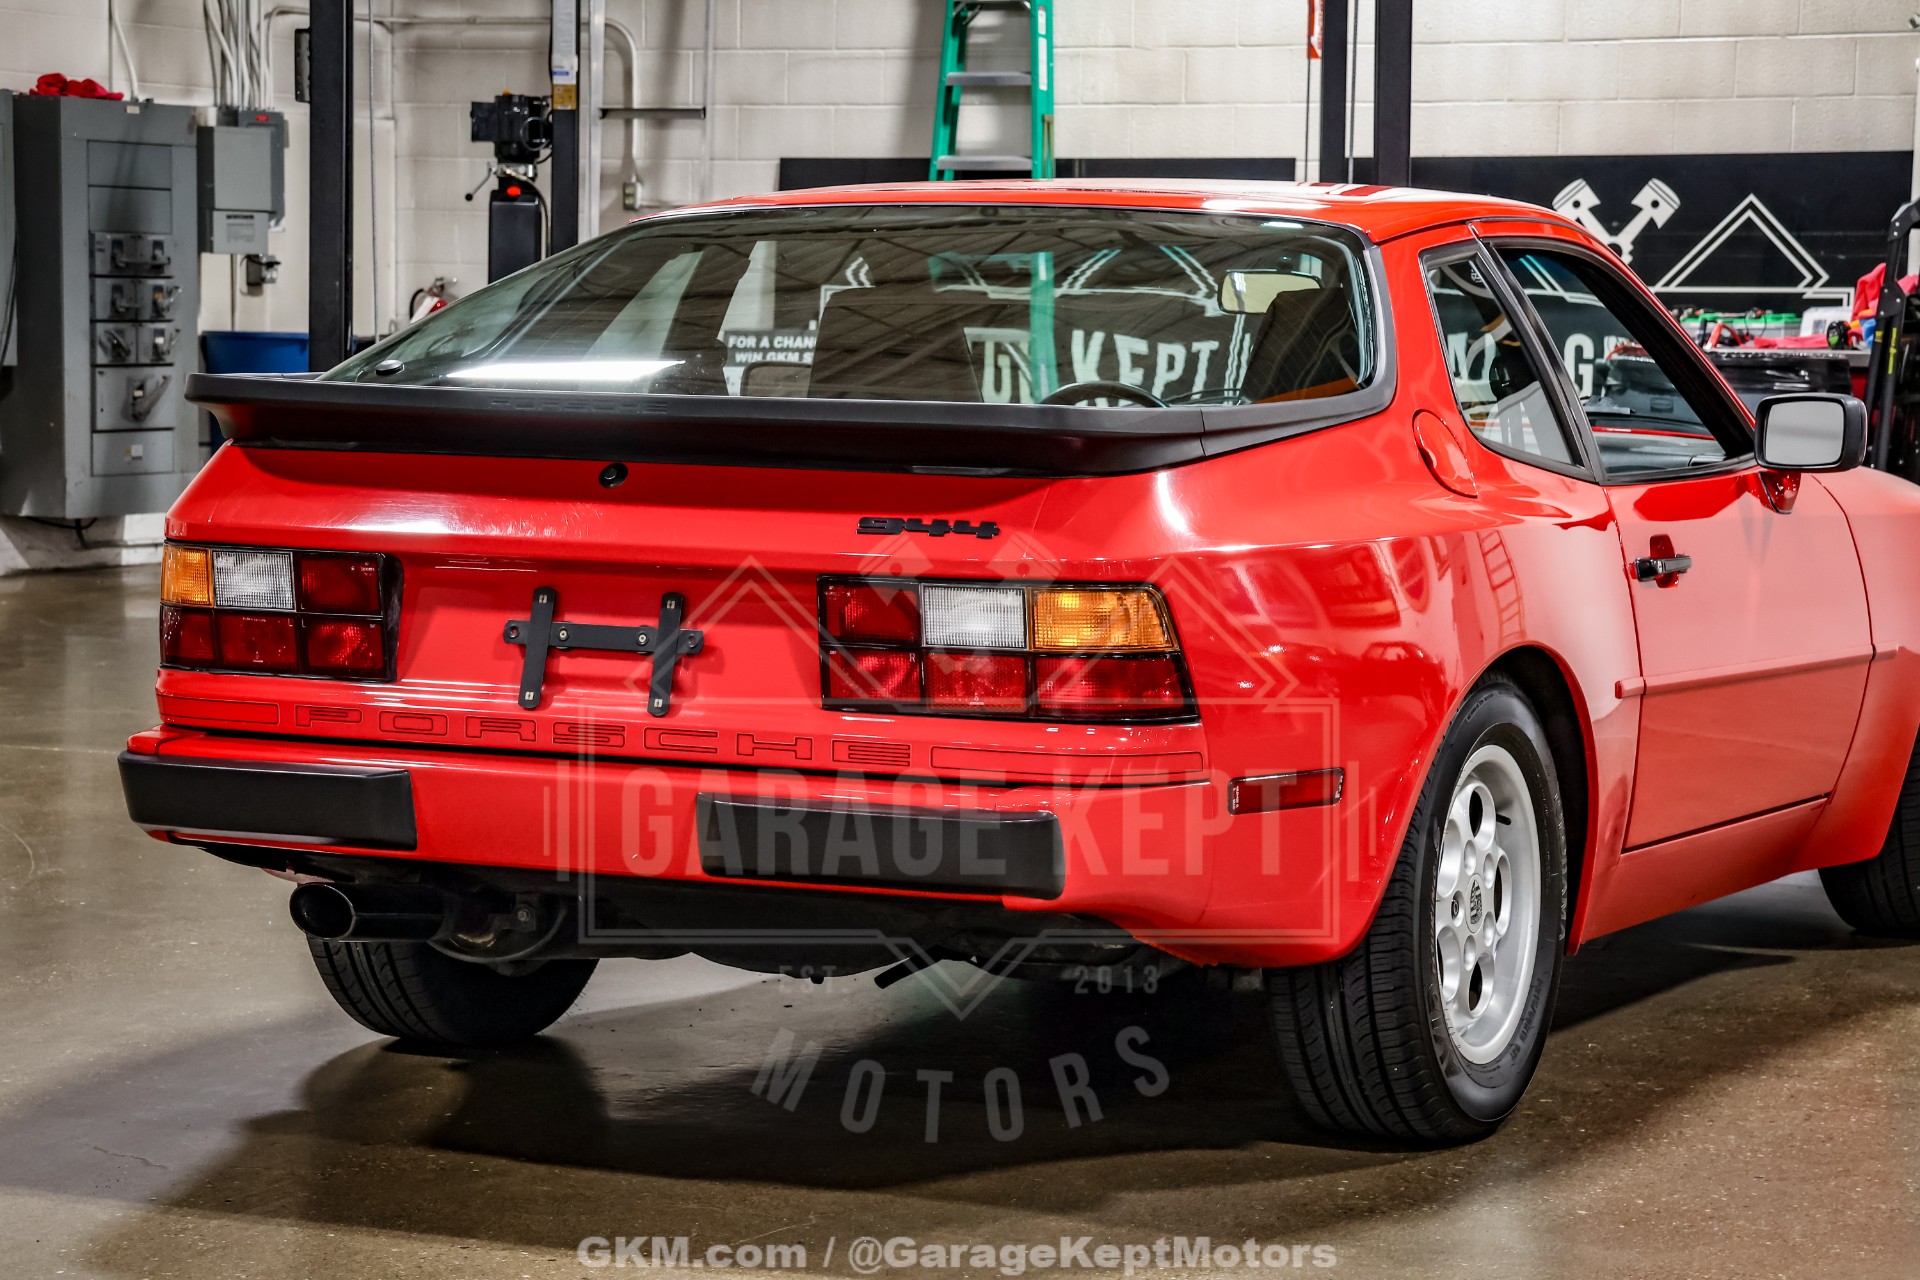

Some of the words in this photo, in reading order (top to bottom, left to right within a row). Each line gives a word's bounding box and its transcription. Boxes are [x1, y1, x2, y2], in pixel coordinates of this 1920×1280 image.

[728, 335, 757, 349] FOR
[760, 335, 770, 349] A
[773, 335, 816, 349] CHAN
[735, 351, 763, 363] WIN
[1071, 329, 1219, 401] KEPT
[856, 516, 1000, 539] 944
[295, 704, 911, 768] PORSCHE
